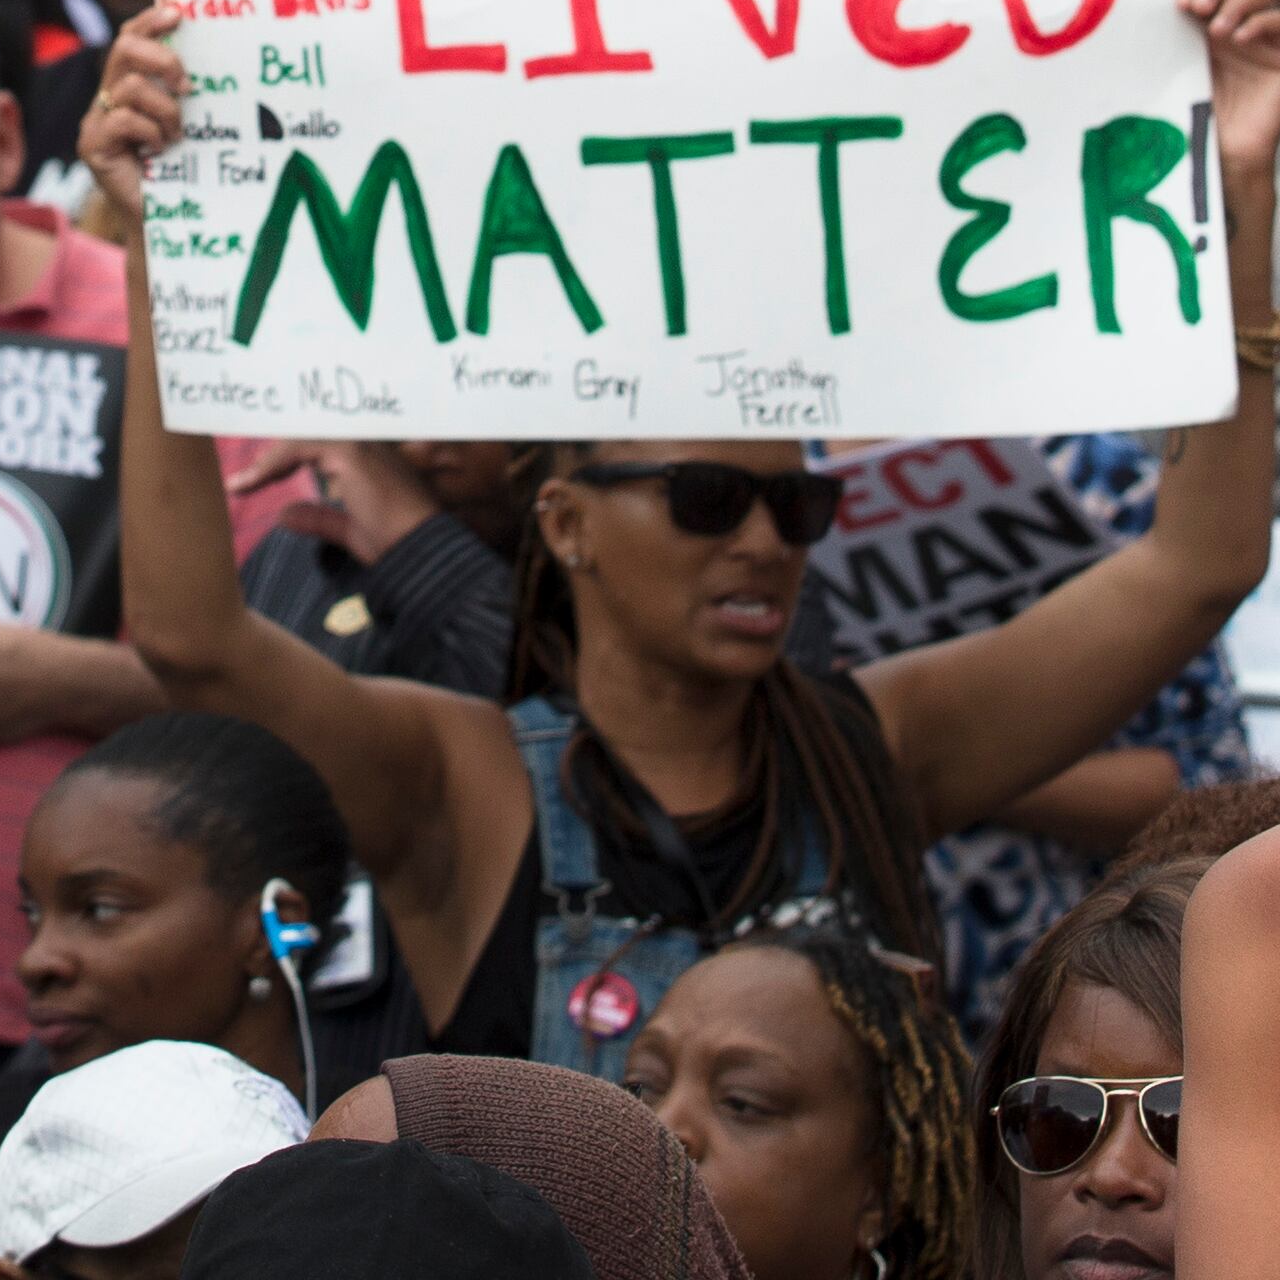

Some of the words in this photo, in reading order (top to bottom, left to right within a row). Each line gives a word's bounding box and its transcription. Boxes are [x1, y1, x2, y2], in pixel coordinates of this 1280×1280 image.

[259, 43, 326, 89] Bell
[231, 100, 1214, 348] MATTER!
[828, 437, 1016, 535] ECT
[817, 484, 1099, 622] MAN
